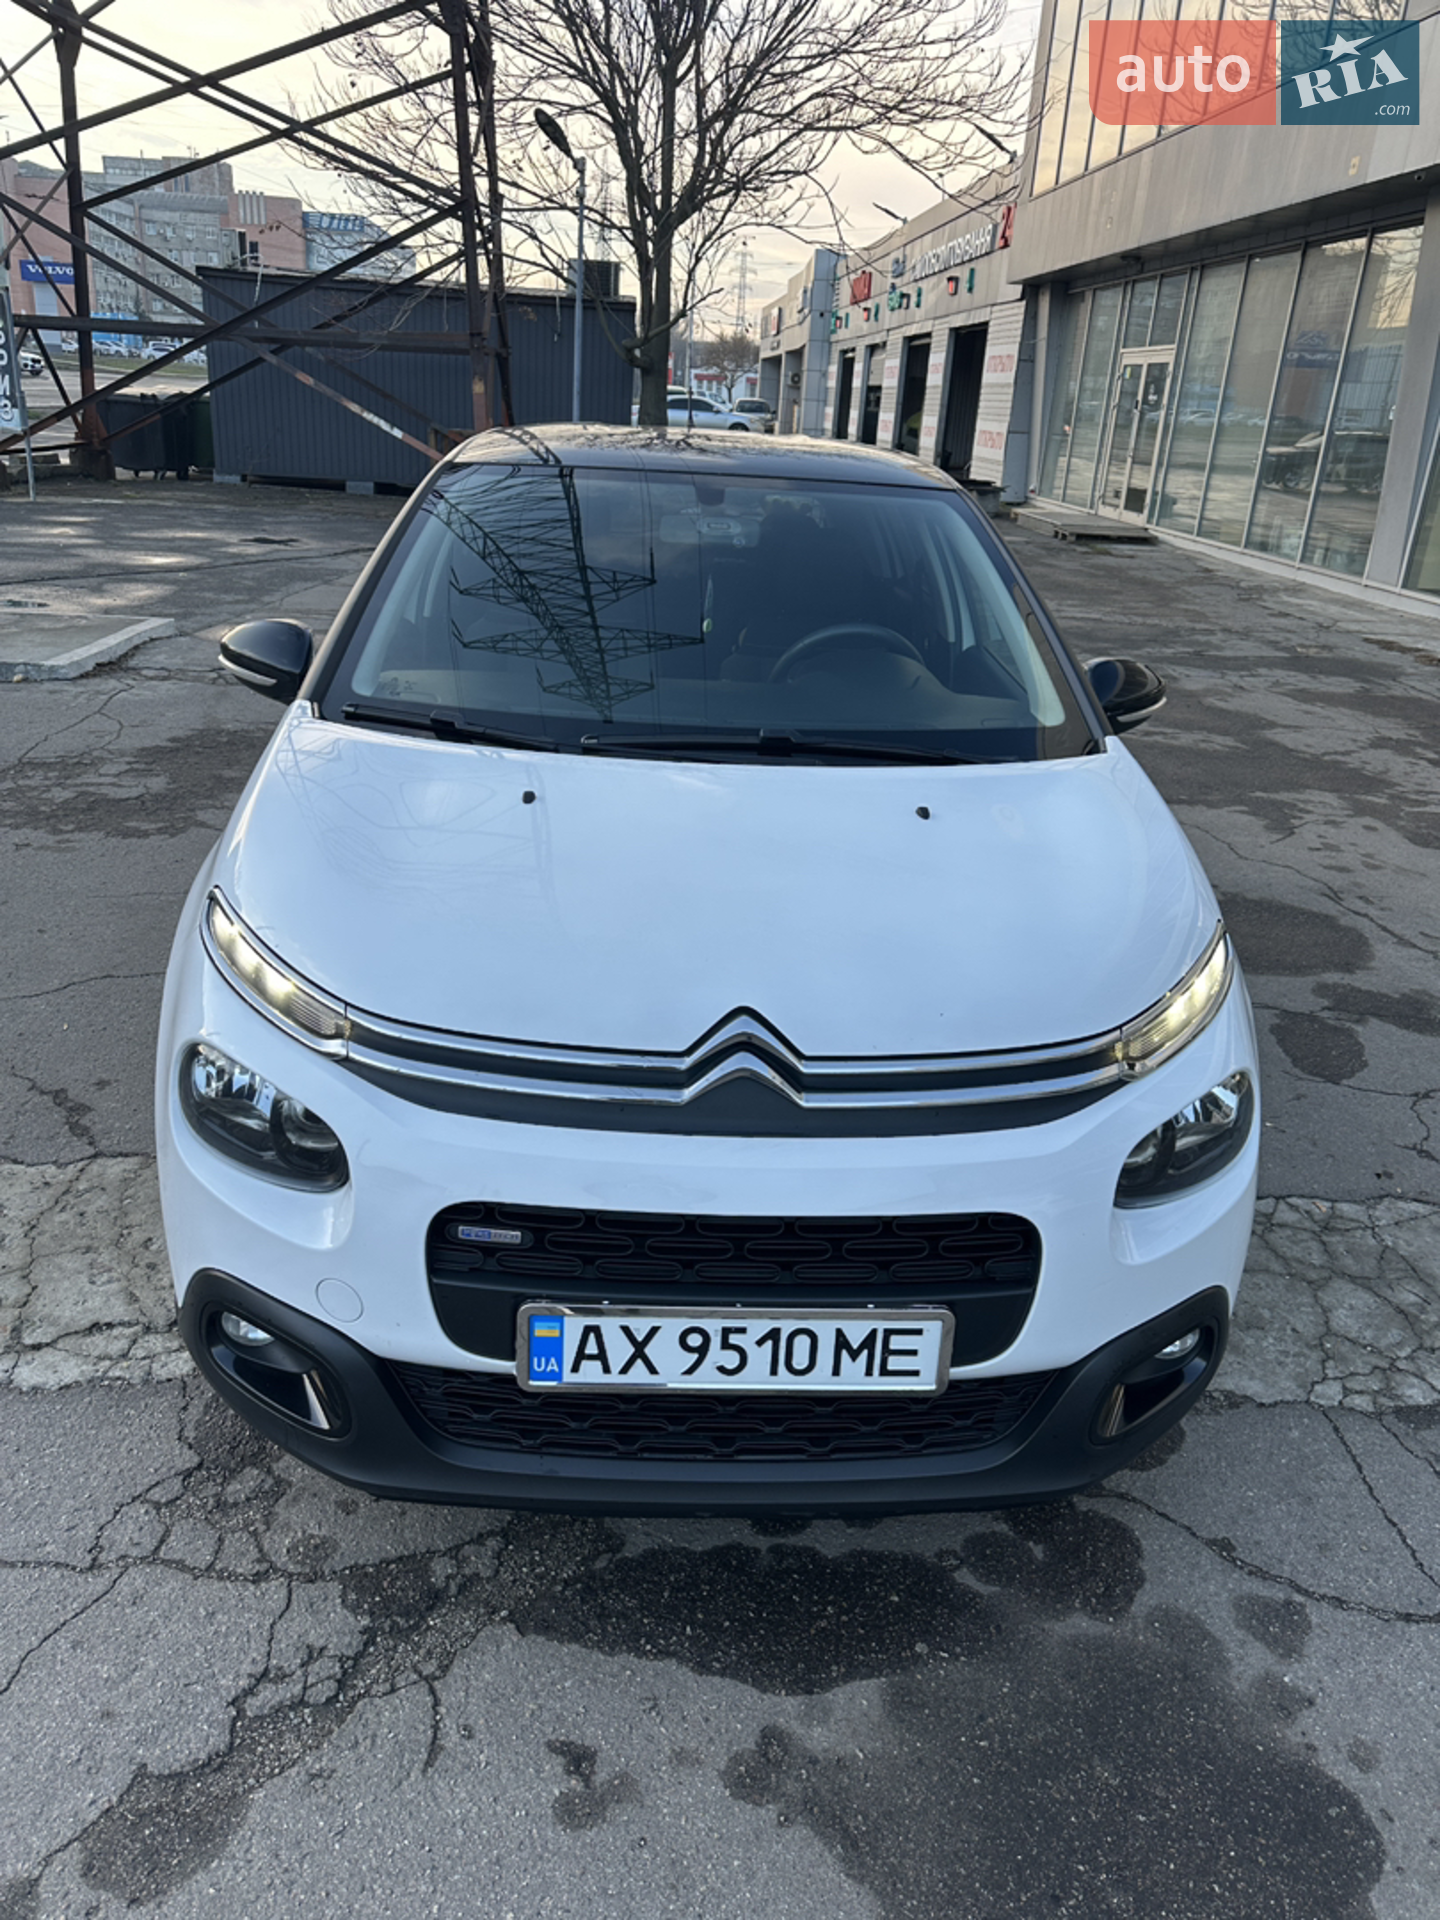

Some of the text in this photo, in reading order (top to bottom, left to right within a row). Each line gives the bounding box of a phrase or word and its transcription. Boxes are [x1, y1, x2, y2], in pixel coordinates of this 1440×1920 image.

[532, 1357, 559, 1373] UA
[569, 1324, 924, 1378] AX 9510 ME
